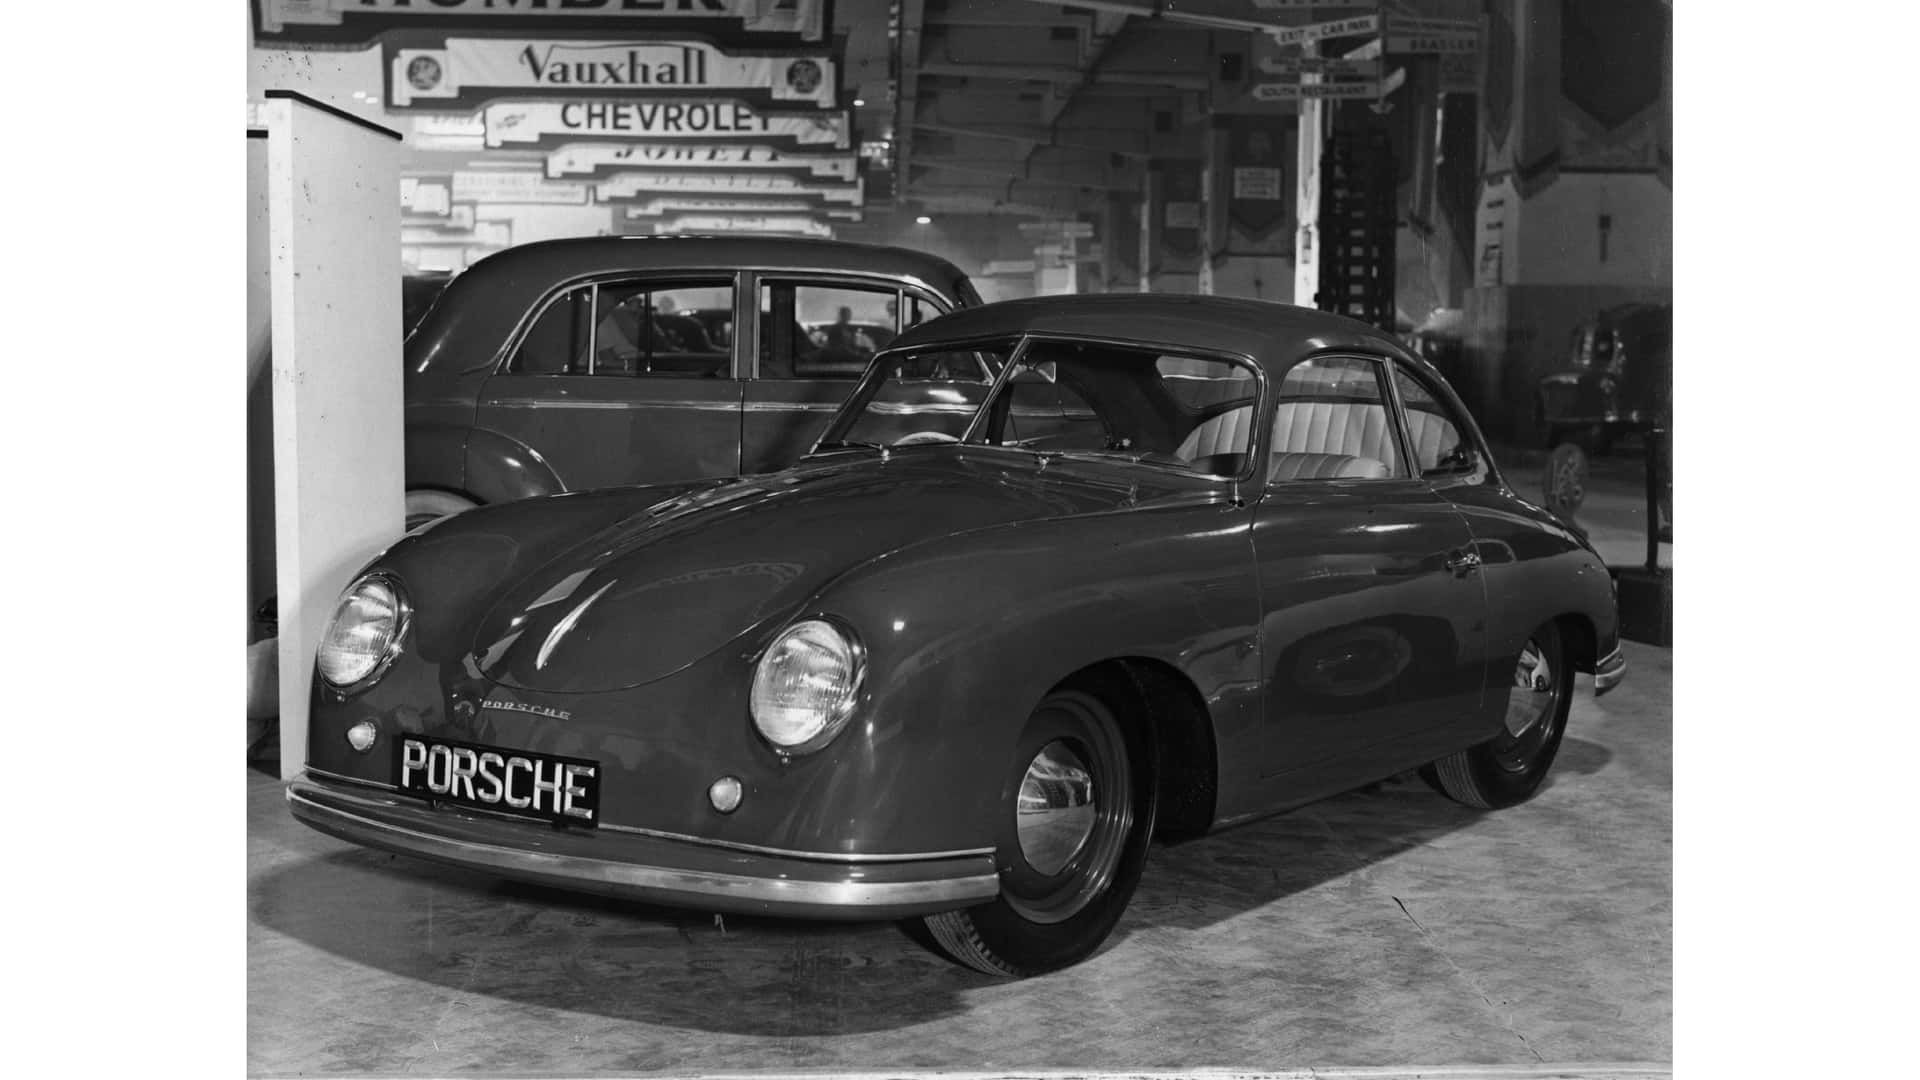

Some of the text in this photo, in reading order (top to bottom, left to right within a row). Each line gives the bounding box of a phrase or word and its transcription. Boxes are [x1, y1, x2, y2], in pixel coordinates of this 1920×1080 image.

[1321, 23, 1344, 36] CAR
[518, 43, 707, 84] Vauxhall
[1261, 86, 1367, 97] SOUTH RESTAURANT
[482, 700, 571, 720] PORSCHE
[402, 739, 595, 820] PORSCHE
